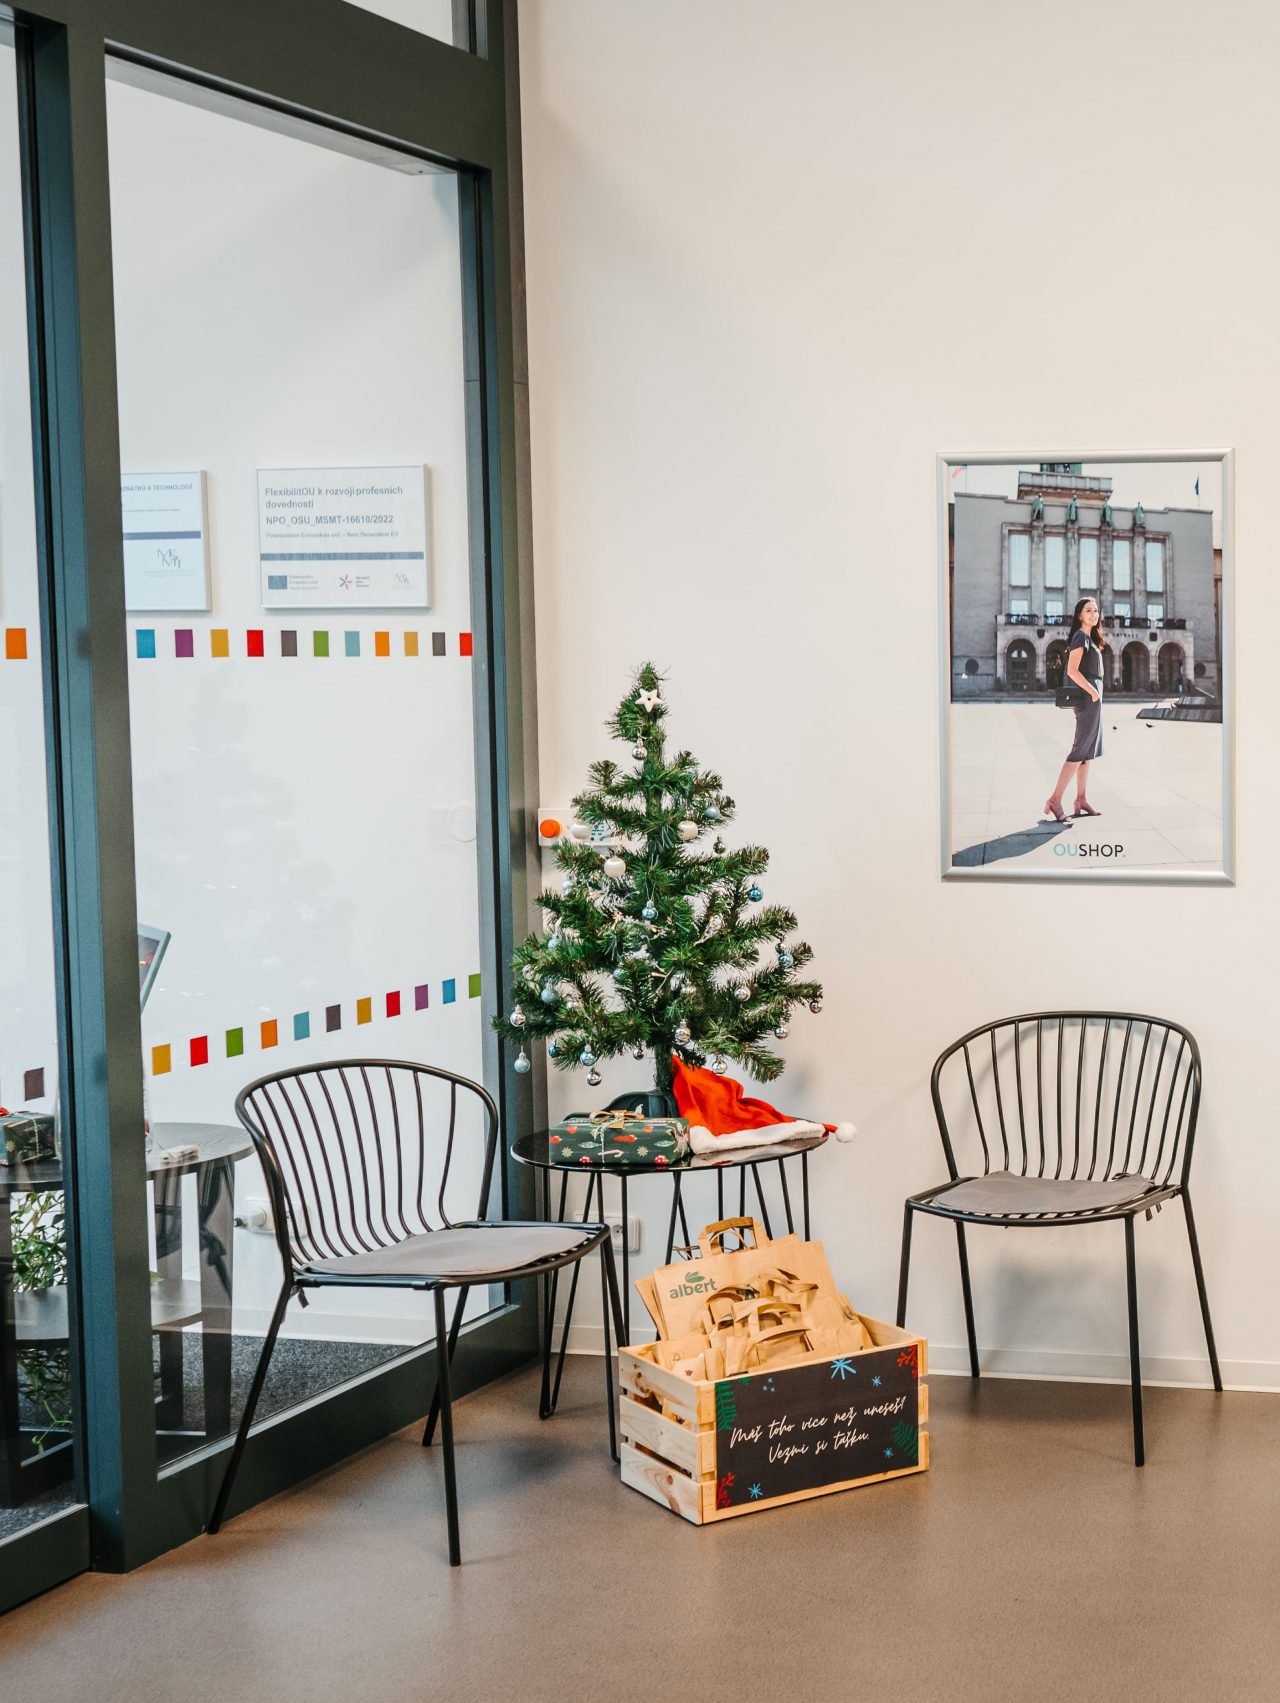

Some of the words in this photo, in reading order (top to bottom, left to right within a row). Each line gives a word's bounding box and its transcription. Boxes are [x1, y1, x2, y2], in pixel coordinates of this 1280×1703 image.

[265, 487, 315, 496] FlexibilitOU
[318, 487, 324, 496] k
[326, 486, 355, 497] rozvoji
[669, 1279, 717, 1299] albert
[730, 1425, 763, 1448] Máš
[768, 1415, 795, 1439] toho
[801, 1417, 829, 1431] více
[834, 1407, 858, 1425] než
[769, 1441, 809, 1465] Vezmi
[815, 1440, 829, 1455] si
[833, 1428, 870, 1451] tašku.
